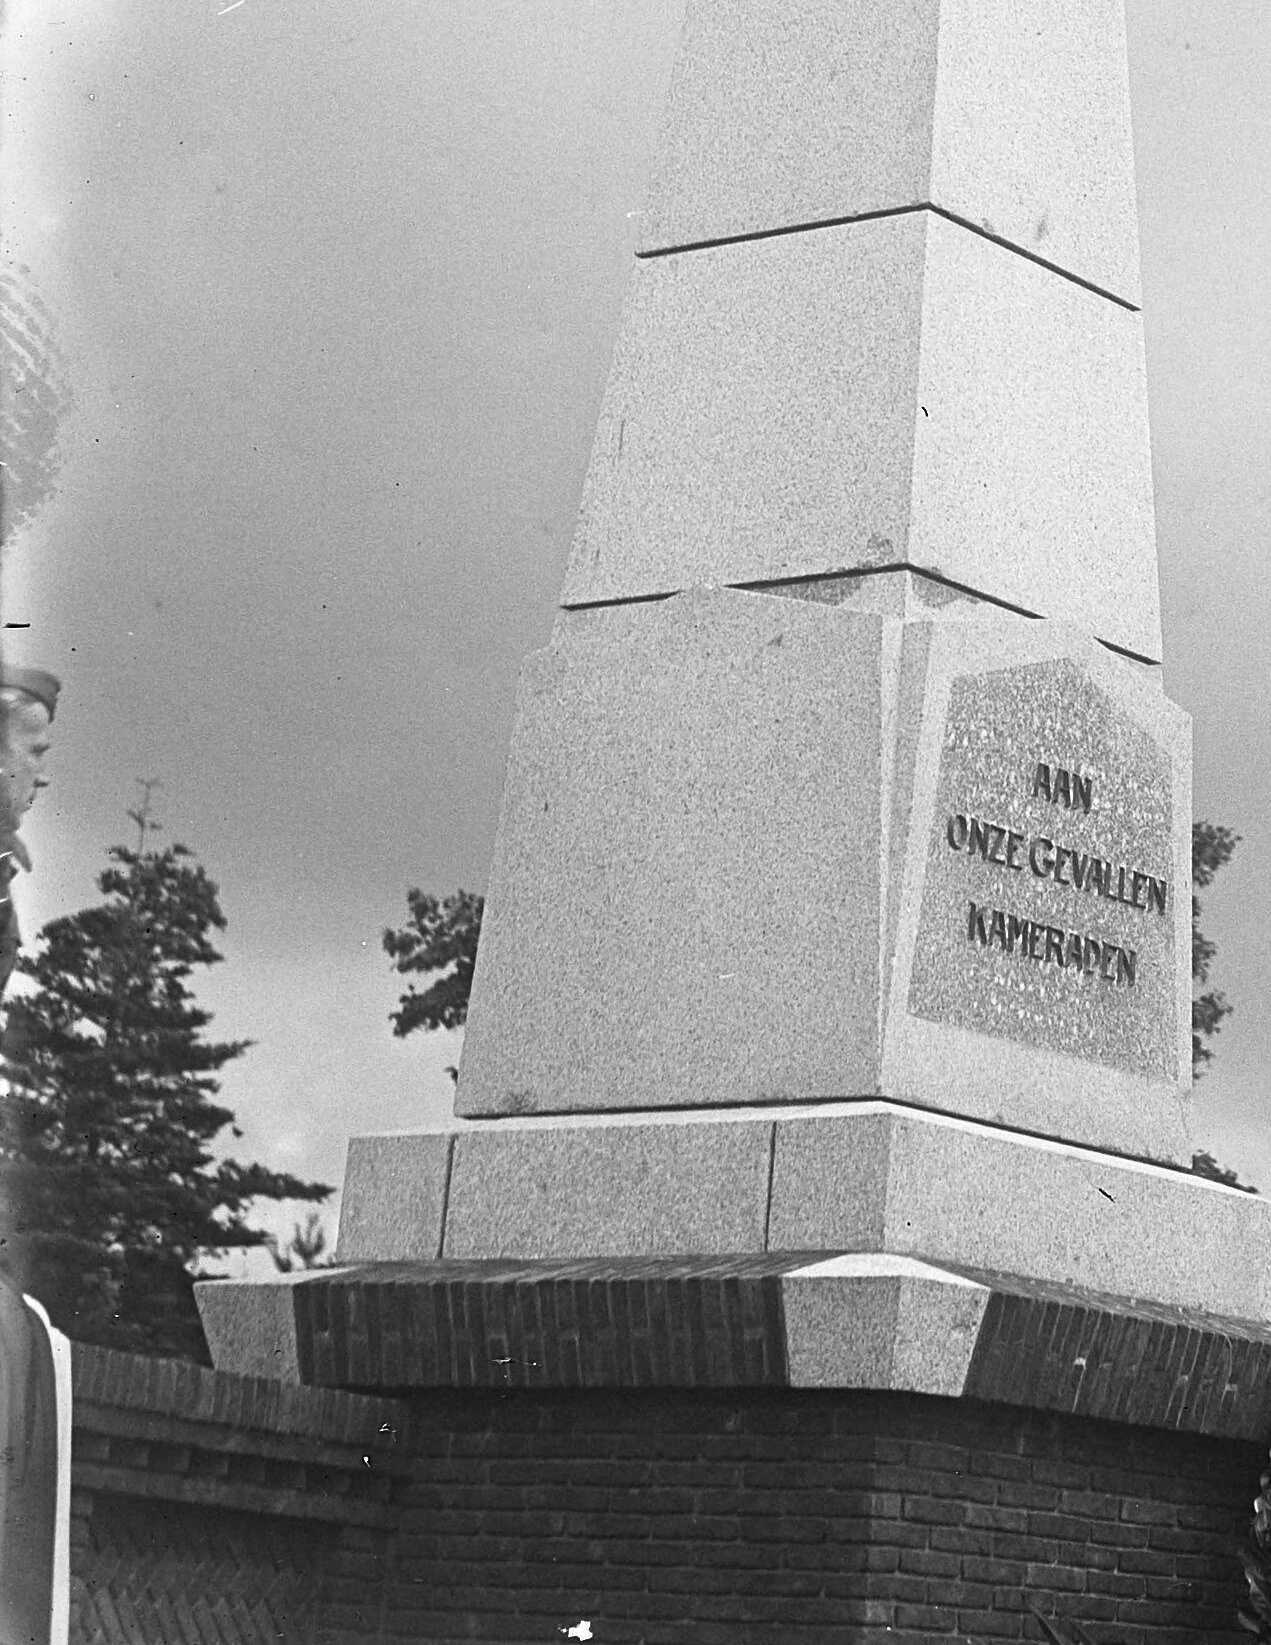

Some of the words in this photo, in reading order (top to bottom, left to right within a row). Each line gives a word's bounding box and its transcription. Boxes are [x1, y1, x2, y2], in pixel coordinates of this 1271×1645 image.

[1032, 763, 1093, 814] AAN
[947, 814, 1024, 871] ONZE
[1029, 837, 1168, 916] GEVALLEN
[967, 901, 1137, 987] KAMERADEN
